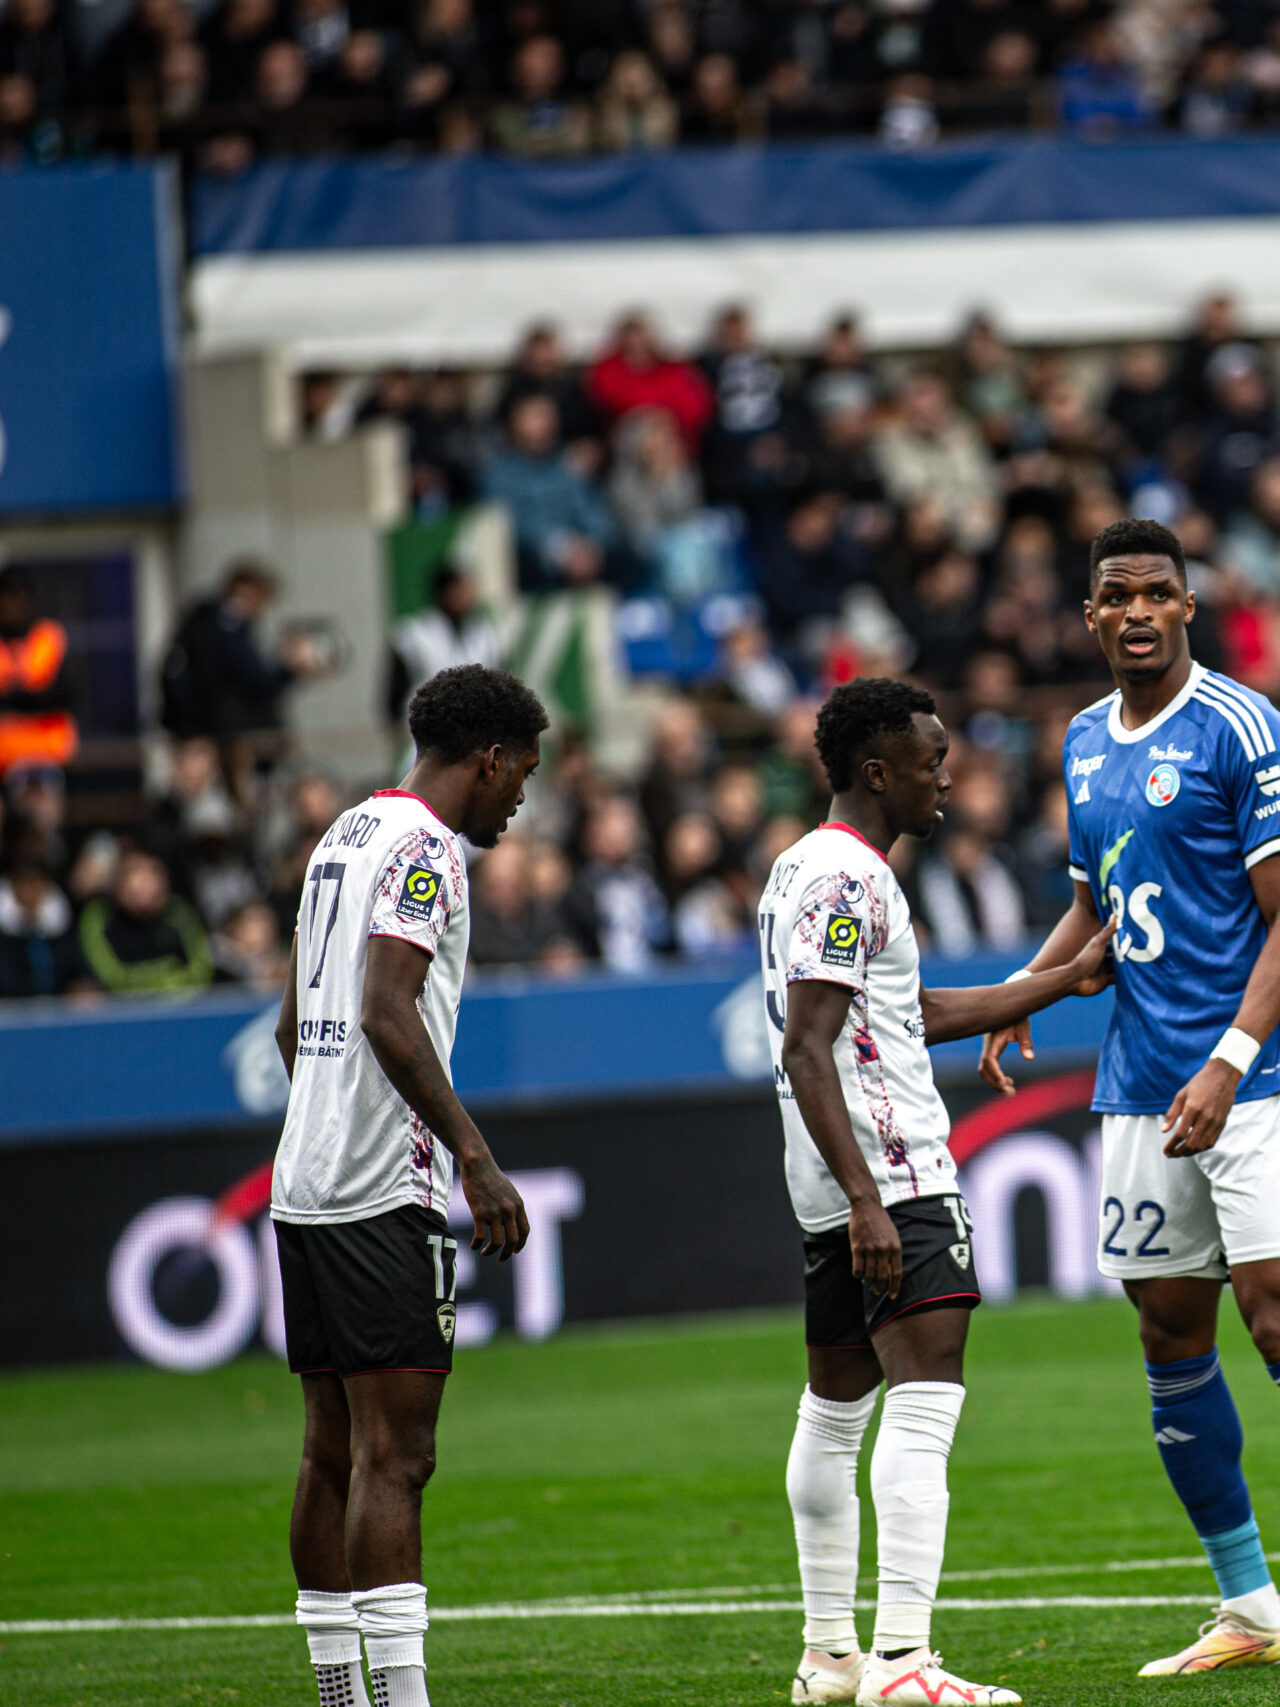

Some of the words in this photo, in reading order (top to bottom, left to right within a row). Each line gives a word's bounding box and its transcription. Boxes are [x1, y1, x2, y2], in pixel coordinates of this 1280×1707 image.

[308, 862, 347, 989] 17
[402, 898, 425, 911] LIGUE
[826, 948, 848, 957] LIGUE
[1103, 1196, 1170, 1257] 22
[426, 1234, 457, 1301] 17
